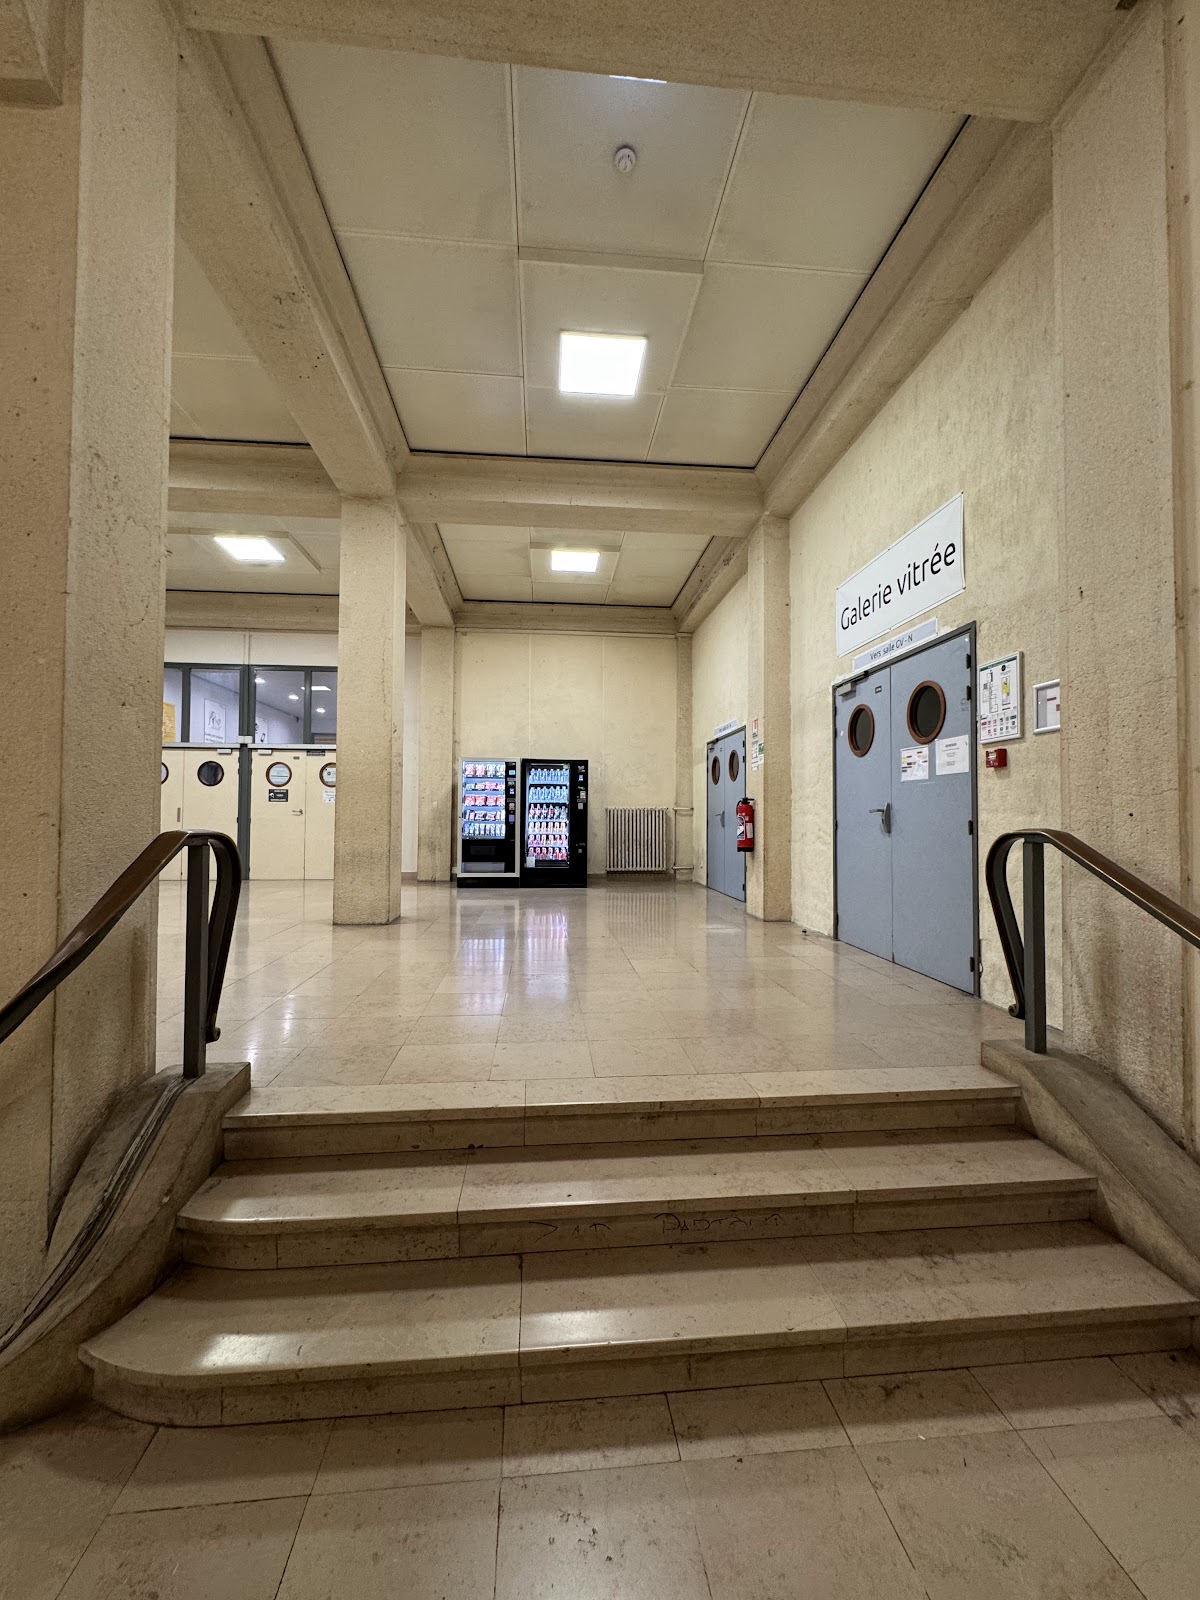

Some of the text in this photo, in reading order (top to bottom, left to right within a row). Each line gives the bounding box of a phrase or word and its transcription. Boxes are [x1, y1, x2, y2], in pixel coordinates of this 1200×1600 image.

[840, 542, 956, 631] Galerie vitrée
[869, 650, 881, 660] Vers
[883, 643, 895, 655] salle
